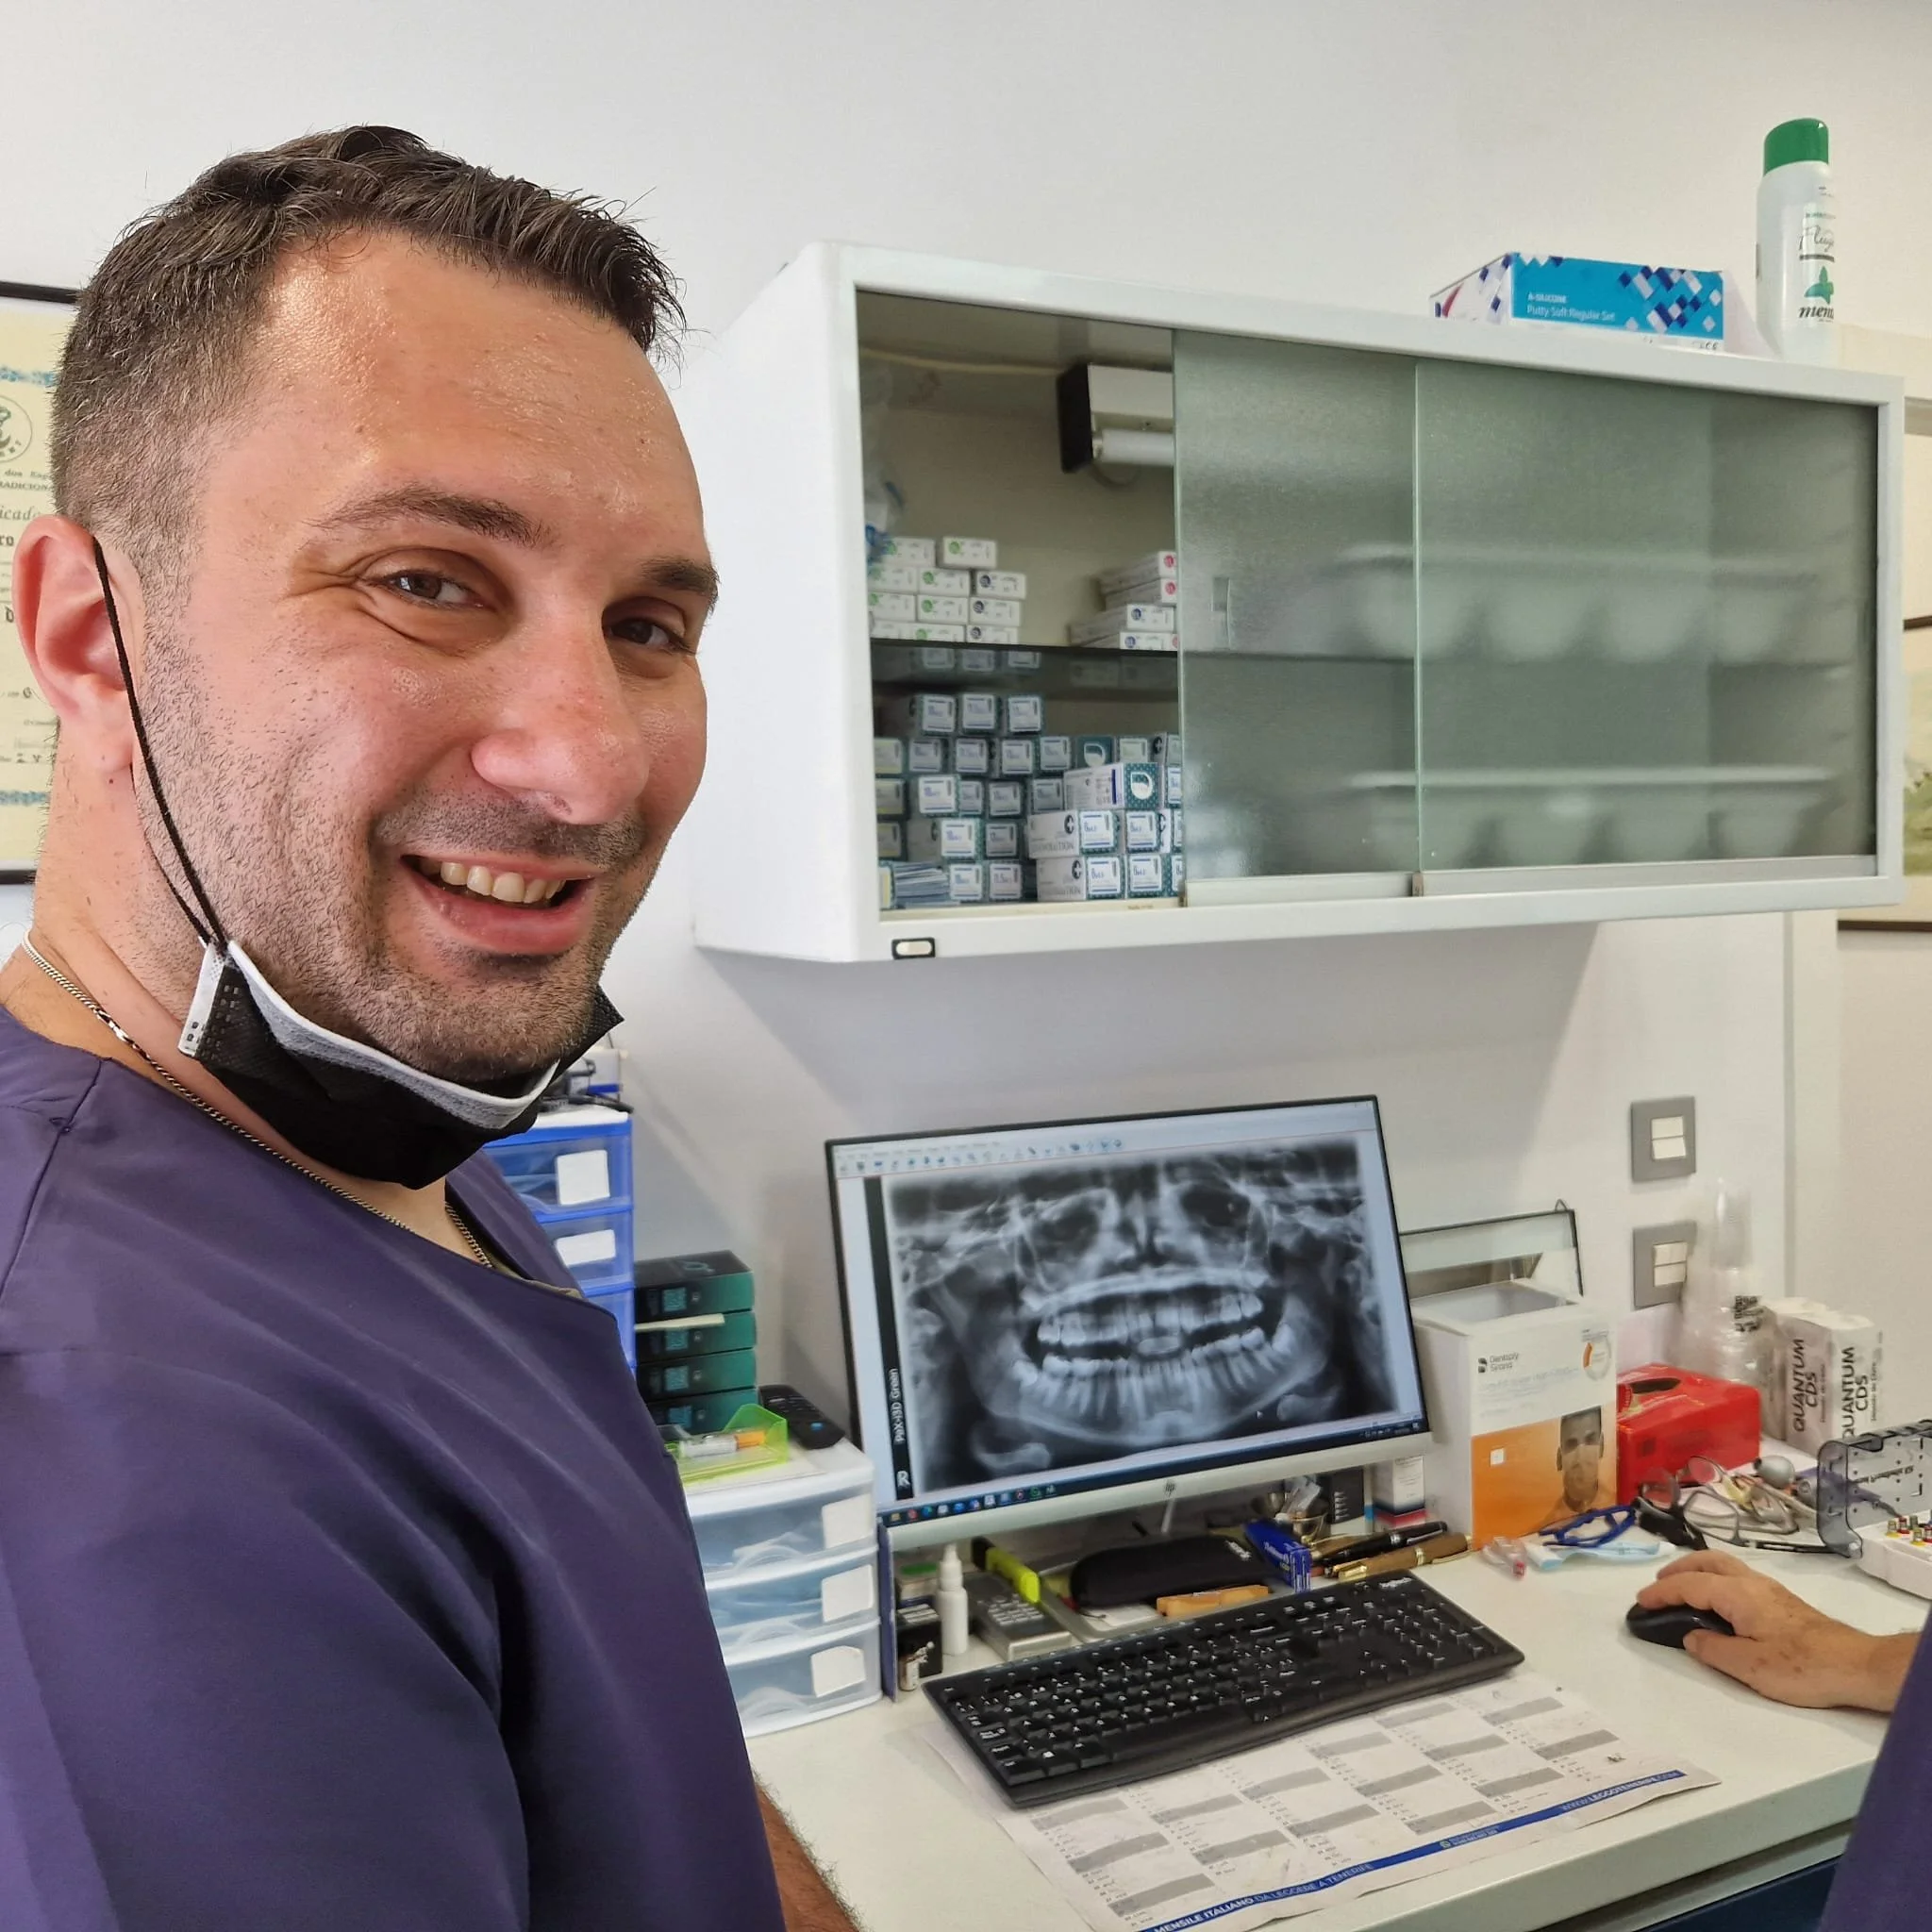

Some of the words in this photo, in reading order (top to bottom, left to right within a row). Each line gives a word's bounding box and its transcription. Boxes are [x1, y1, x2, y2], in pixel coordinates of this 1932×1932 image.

[888, 1368, 901, 1399] Green
[1792, 1339, 1806, 1432] QUANTUM
[1806, 1372, 1819, 1407] CDS
[1856, 1374, 1869, 1411] CDS
[896, 1470, 910, 1488] R
[1154, 1913, 1202, 1932] MENSILE
[1202, 1898, 1254, 1921] ITALIANO
